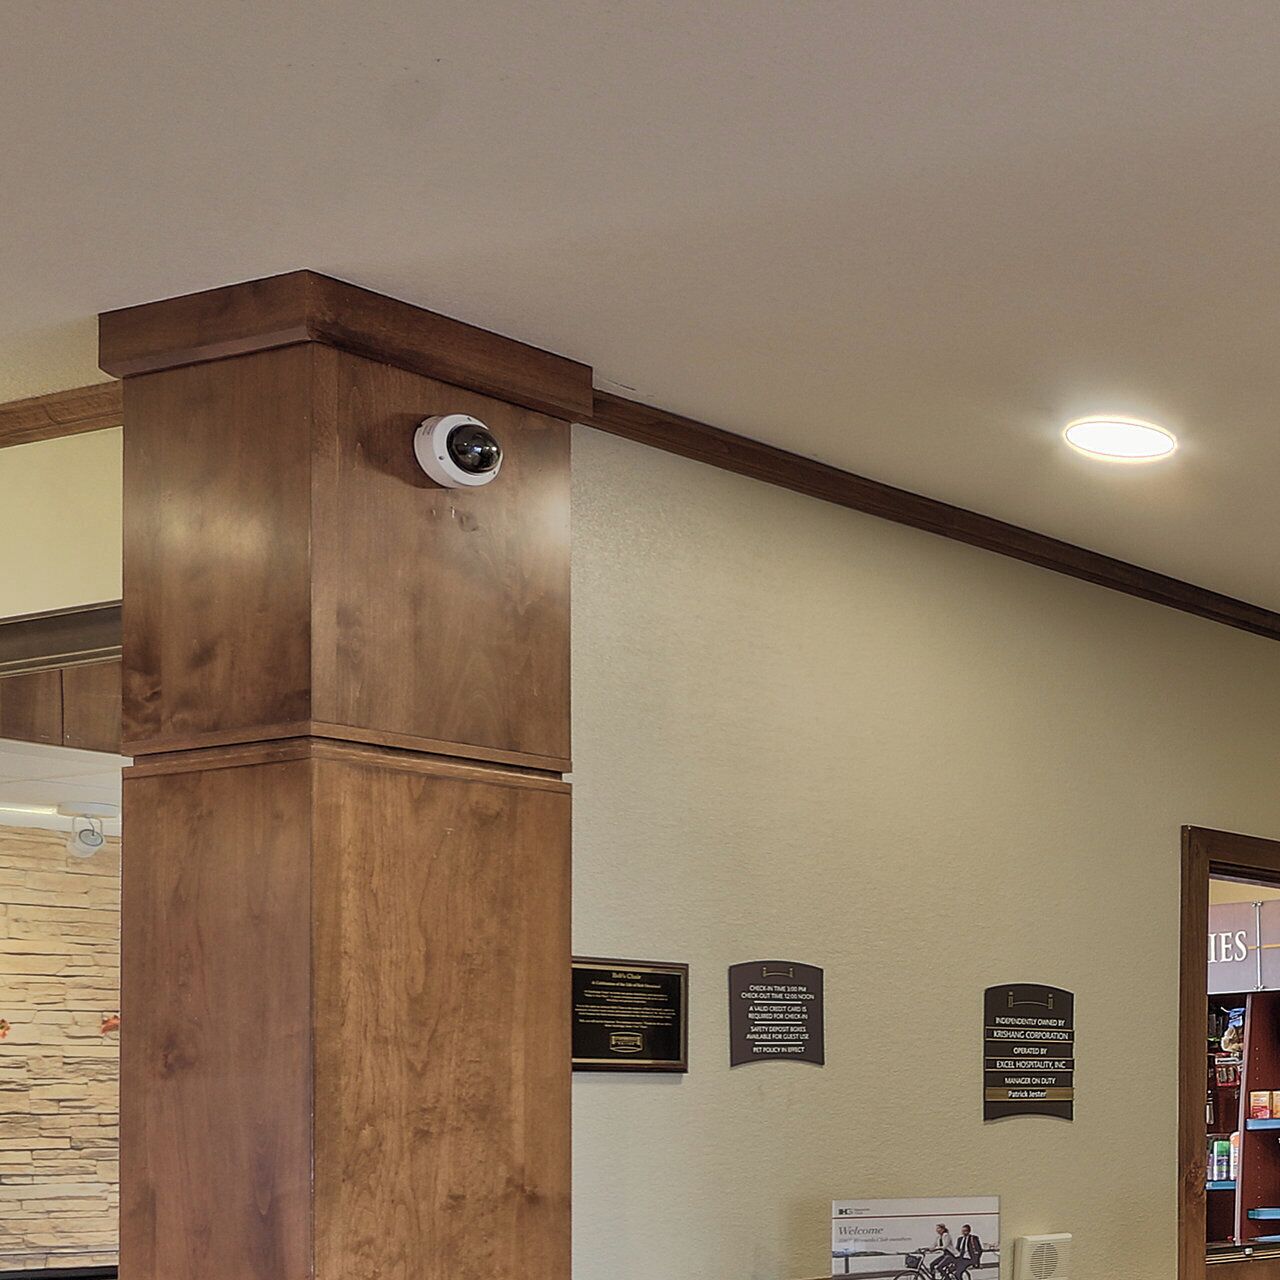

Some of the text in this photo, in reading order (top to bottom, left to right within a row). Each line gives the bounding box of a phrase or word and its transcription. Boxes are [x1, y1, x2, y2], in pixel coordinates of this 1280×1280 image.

[995, 1017, 1037, 1025] INDEPENDENTLY
[1026, 1031, 1068, 1039] CORPORATION
[1016, 1061, 1054, 1069] HOSPITALITY,
[839, 1226, 884, 1235] Welcome
